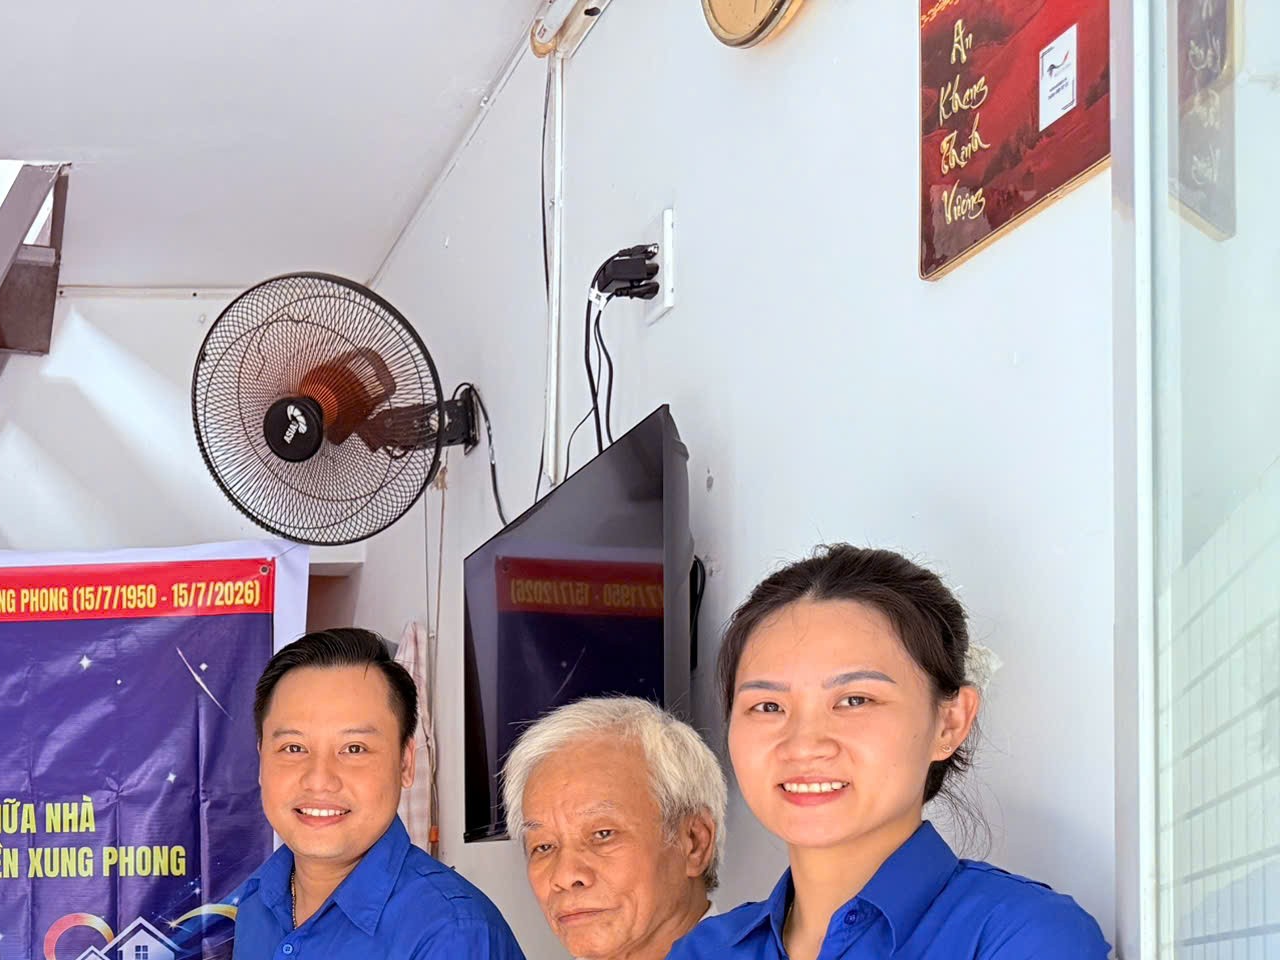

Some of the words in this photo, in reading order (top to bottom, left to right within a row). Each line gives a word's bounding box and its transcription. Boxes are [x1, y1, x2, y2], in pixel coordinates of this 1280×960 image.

[950, 19, 972, 64] An
[939, 74, 988, 127] Khang
[21, 588, 68, 612] PHONG
[73, 584, 156, 612] (15/7/1950
[172, 580, 259, 607] 15/7/2026)
[46, 795, 95, 832] NHÀ
[28, 846, 93, 877] XUNG
[103, 845, 185, 876] PHONG
